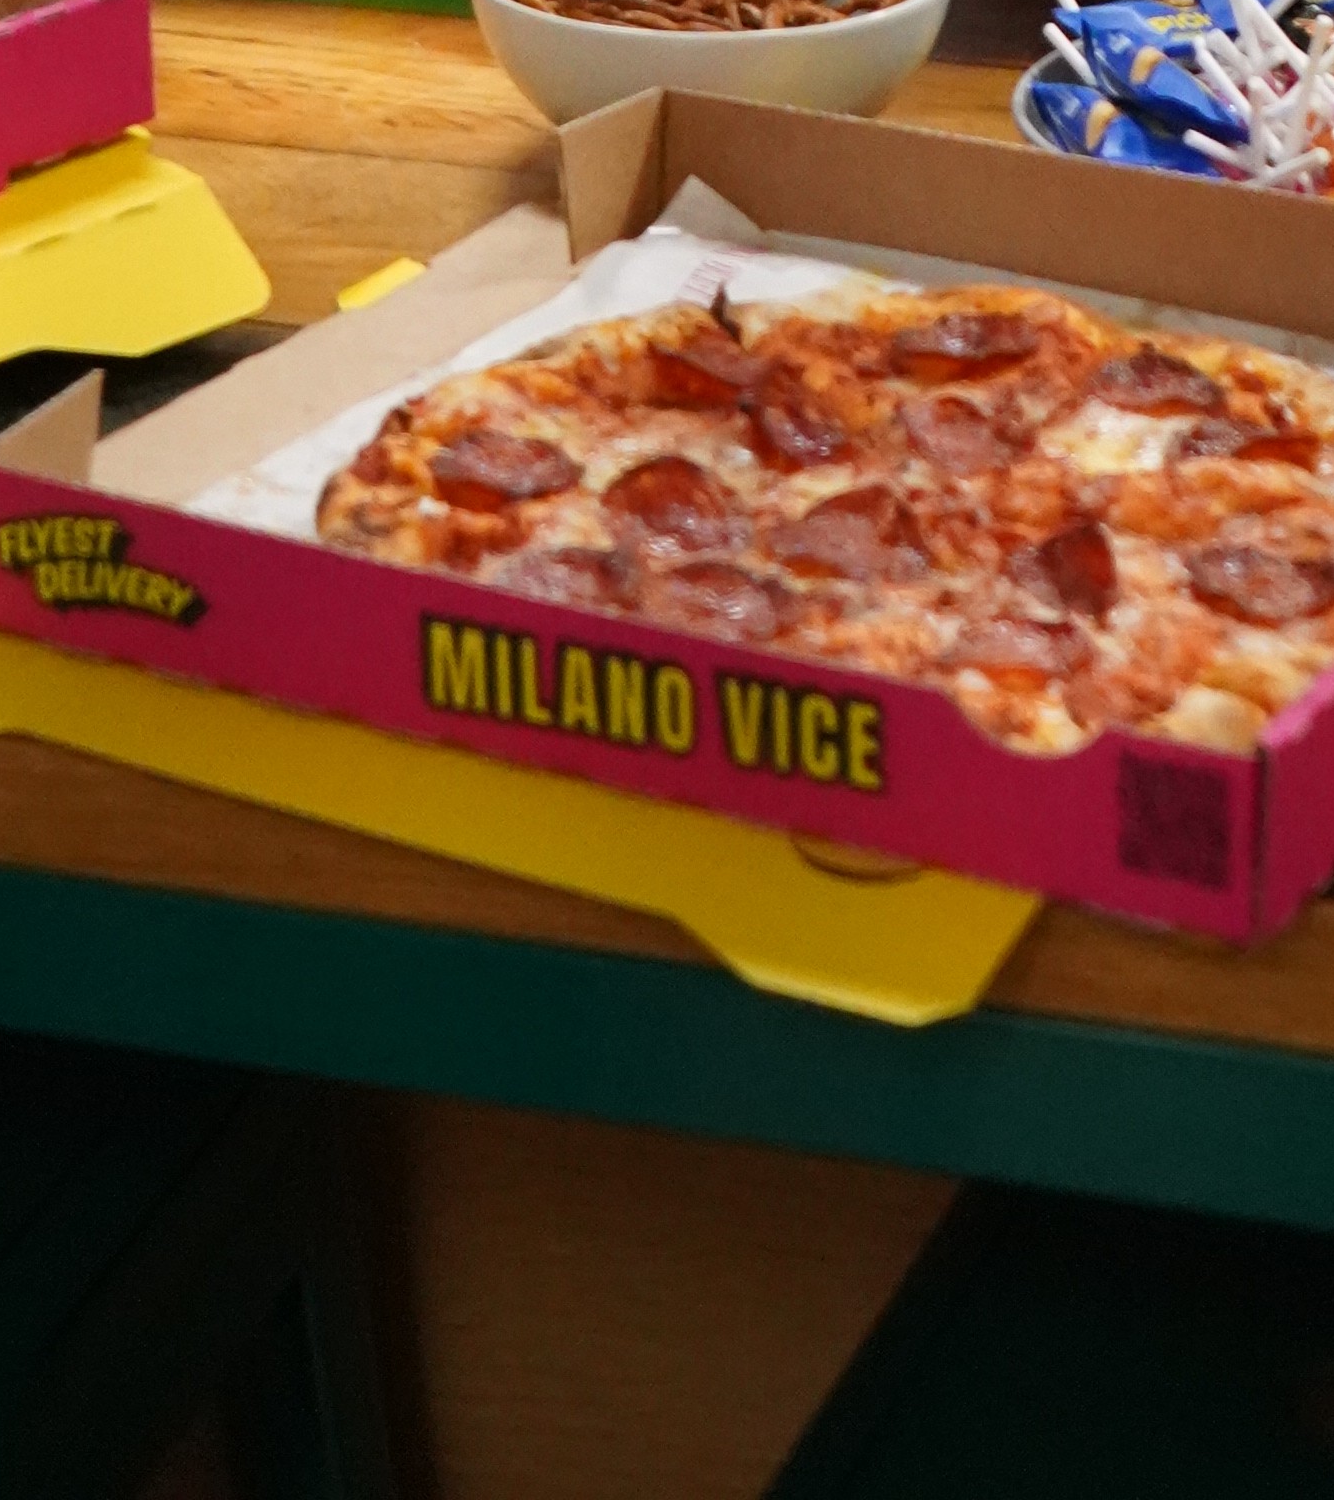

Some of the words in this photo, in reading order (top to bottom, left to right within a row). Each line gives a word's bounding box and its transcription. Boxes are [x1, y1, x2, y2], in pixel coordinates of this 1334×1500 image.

[36, 559, 195, 617] DELIVERY
[427, 620, 695, 754] MILANO
[724, 676, 883, 791] VICE
